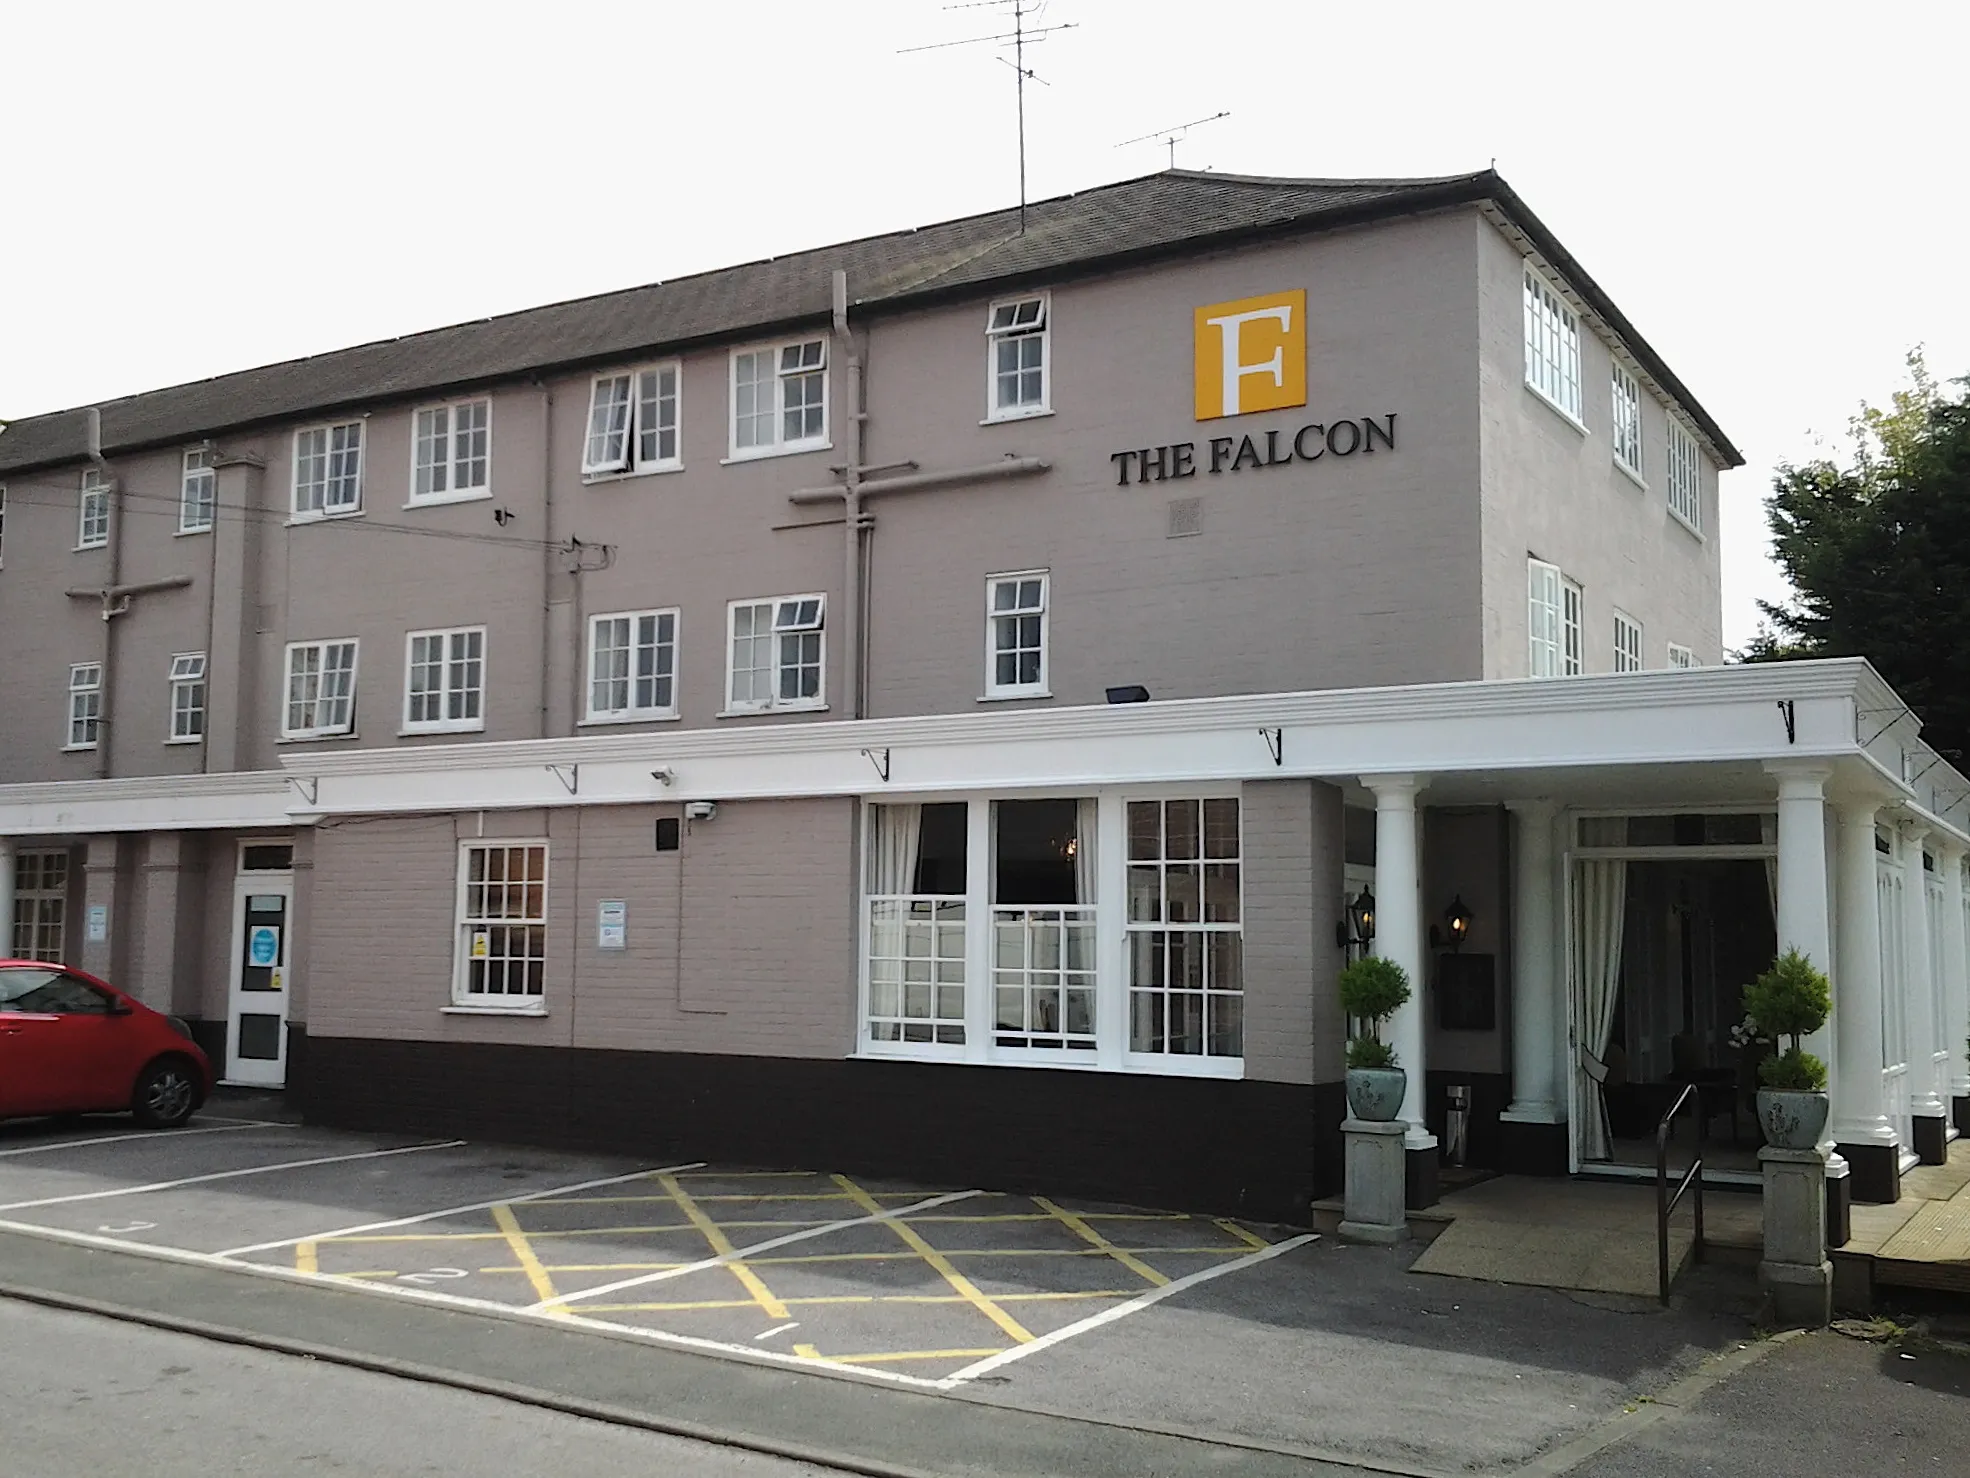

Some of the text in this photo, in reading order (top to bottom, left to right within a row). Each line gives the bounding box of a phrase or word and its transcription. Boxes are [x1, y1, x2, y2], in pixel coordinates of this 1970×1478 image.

[1206, 305, 1292, 417] F
[1110, 413, 1397, 486] THE FALCON
[396, 1267, 469, 1285] 2
